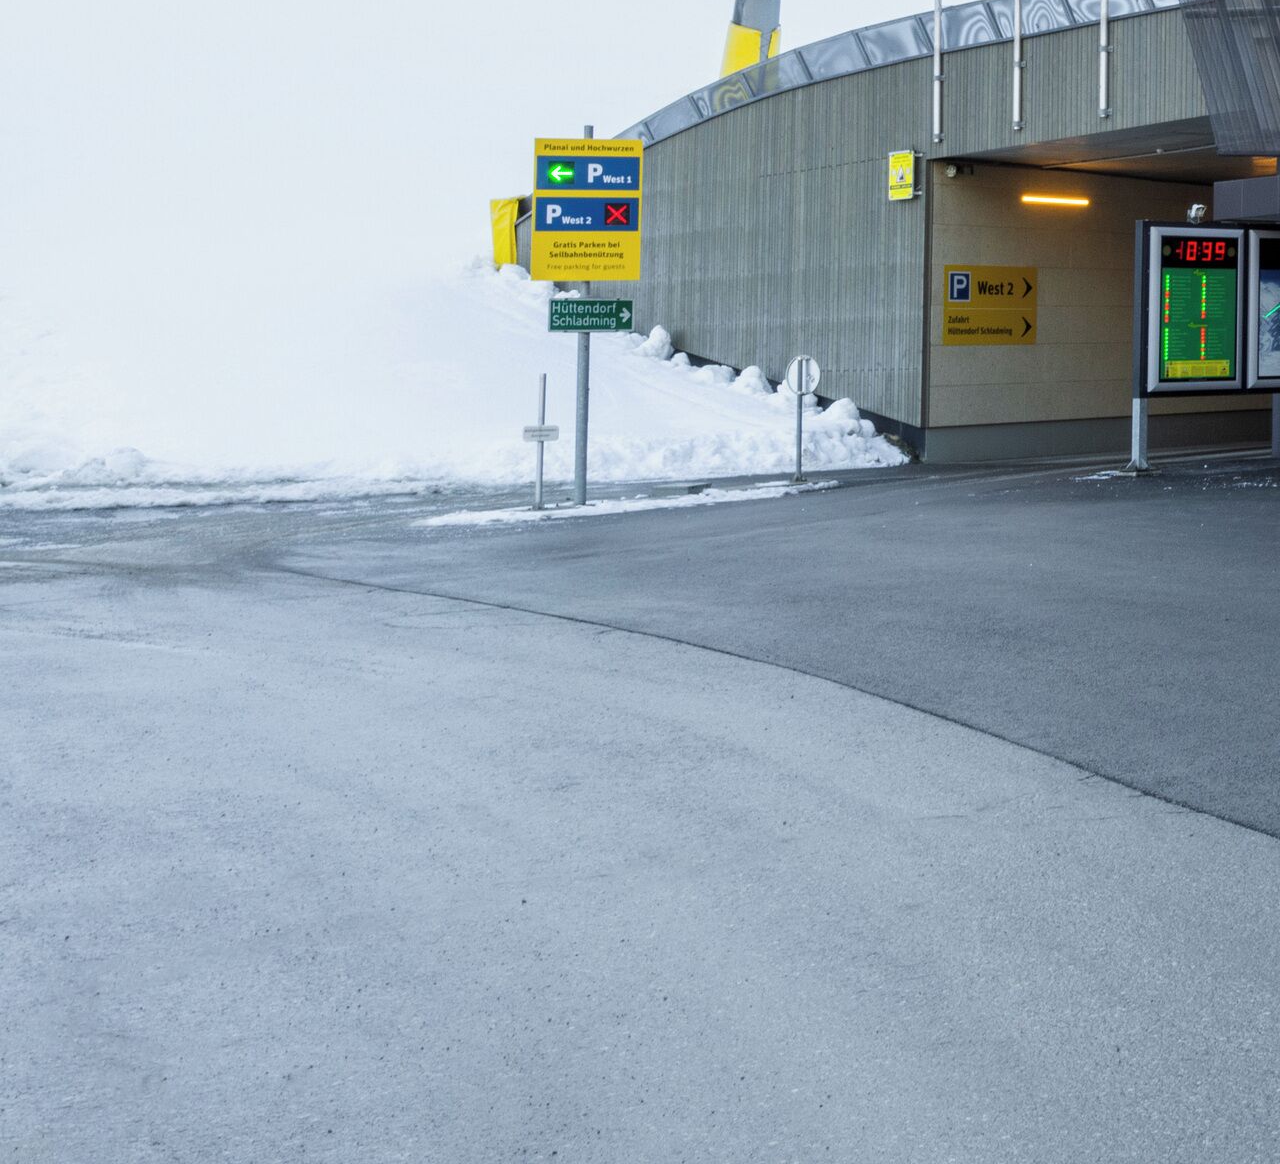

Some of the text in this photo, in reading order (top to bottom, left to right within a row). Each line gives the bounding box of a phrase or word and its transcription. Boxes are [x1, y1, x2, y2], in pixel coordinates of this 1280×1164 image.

[543, 143, 635, 153] Planai und Hochwurzen
[587, 163, 633, 184] P West 1
[545, 204, 593, 225] P West 2
[553, 241, 621, 249] Gratis Parken bei
[549, 250, 625, 260] Seilbahnbenützung
[953, 274, 1014, 299] P West 2
[551, 302, 617, 314] Hüttendorf
[551, 315, 617, 329] Schladming
[947, 316, 970, 324] Zufahrt
[947, 326, 1013, 337] Hüttendorf Schladming
